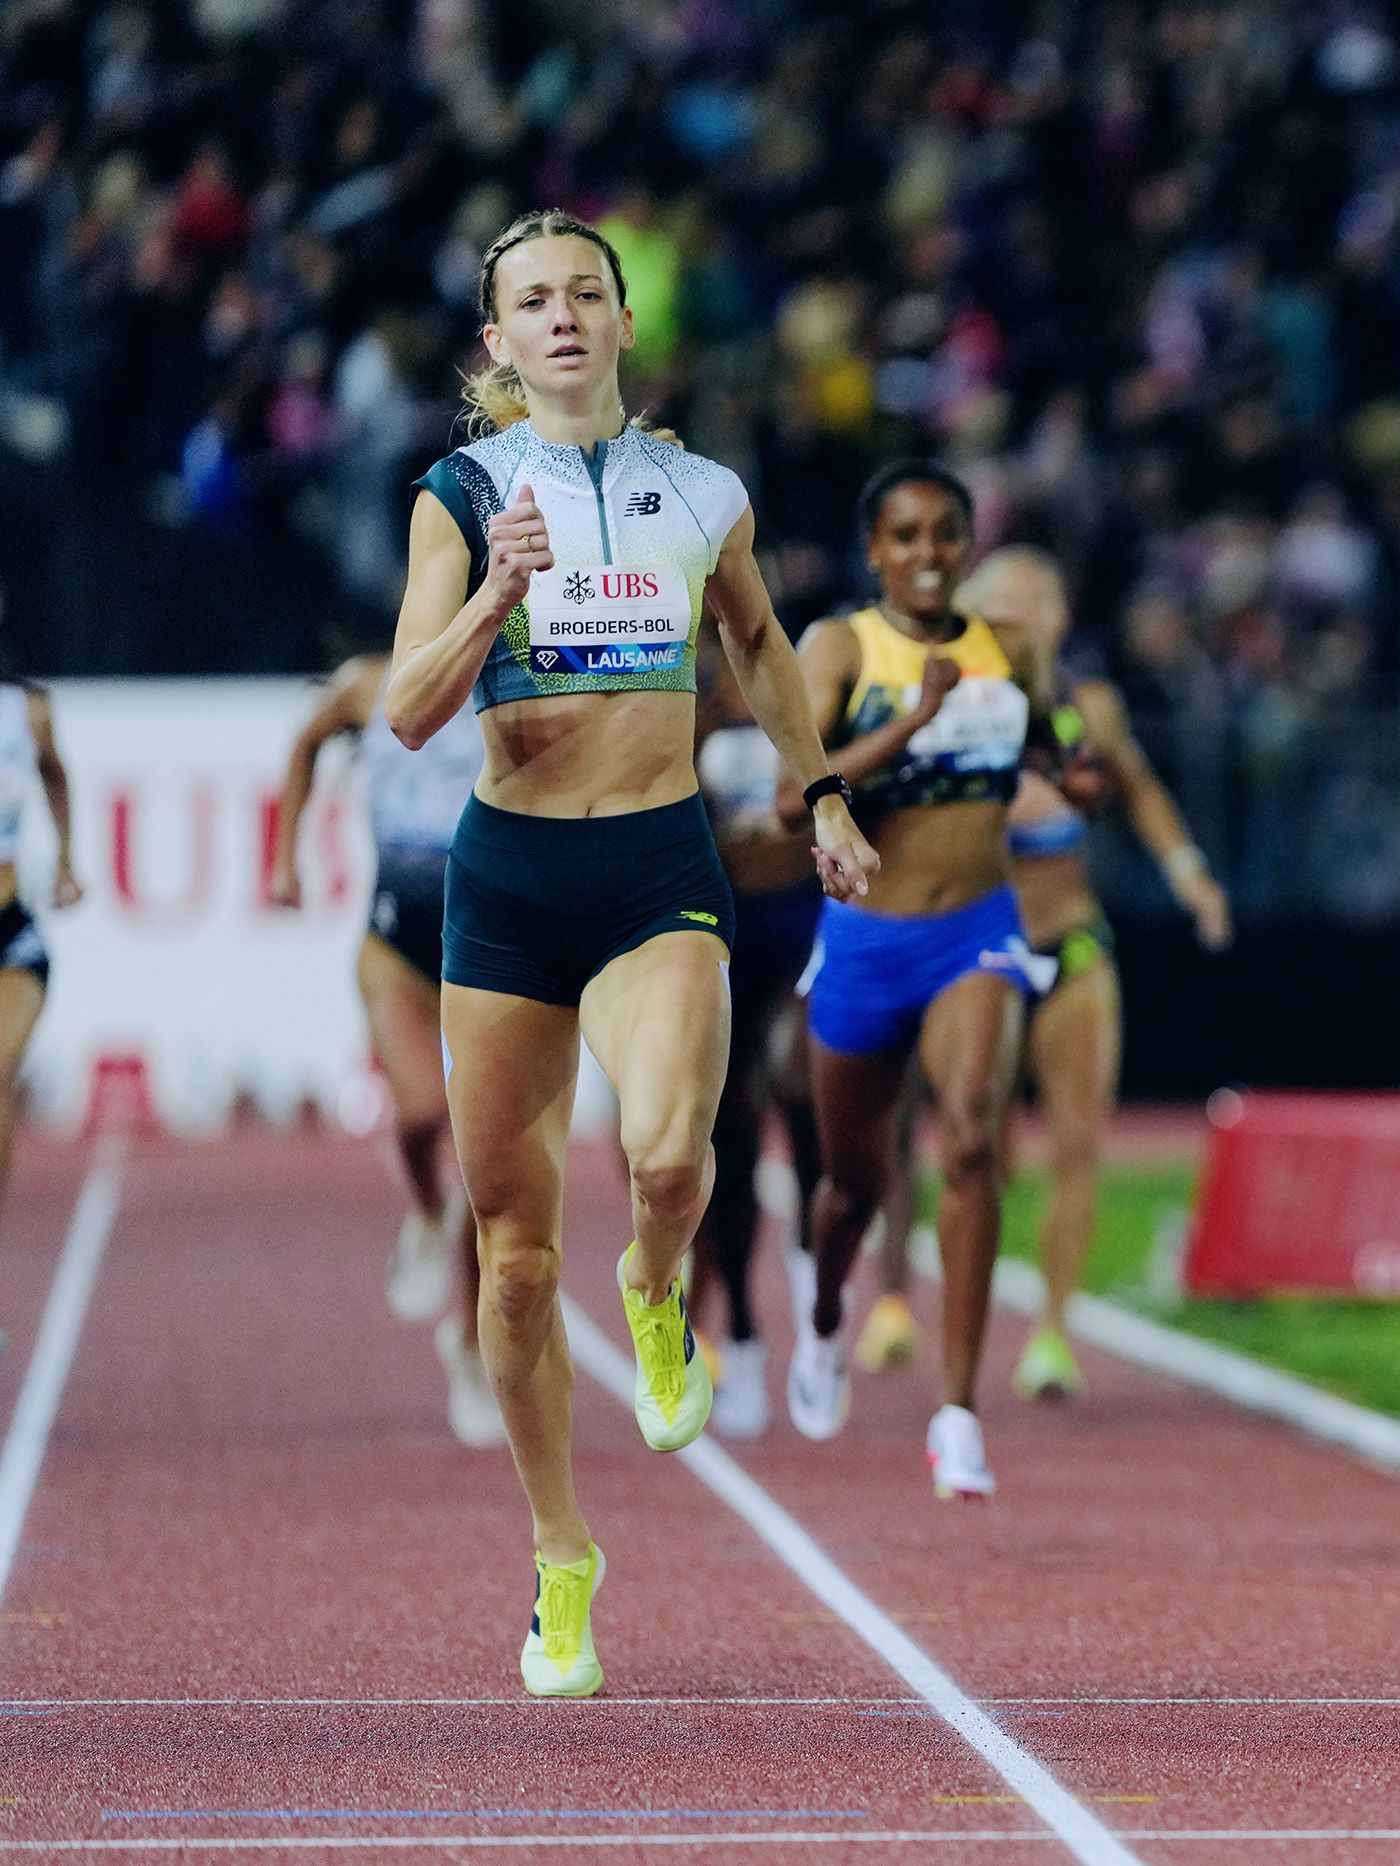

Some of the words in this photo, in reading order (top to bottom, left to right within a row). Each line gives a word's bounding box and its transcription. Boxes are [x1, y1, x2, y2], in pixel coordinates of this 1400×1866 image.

[601, 572, 658, 598] UBS
[550, 618, 675, 635] BROEDERS-BOL
[587, 649, 677, 669] LAUSANNE
